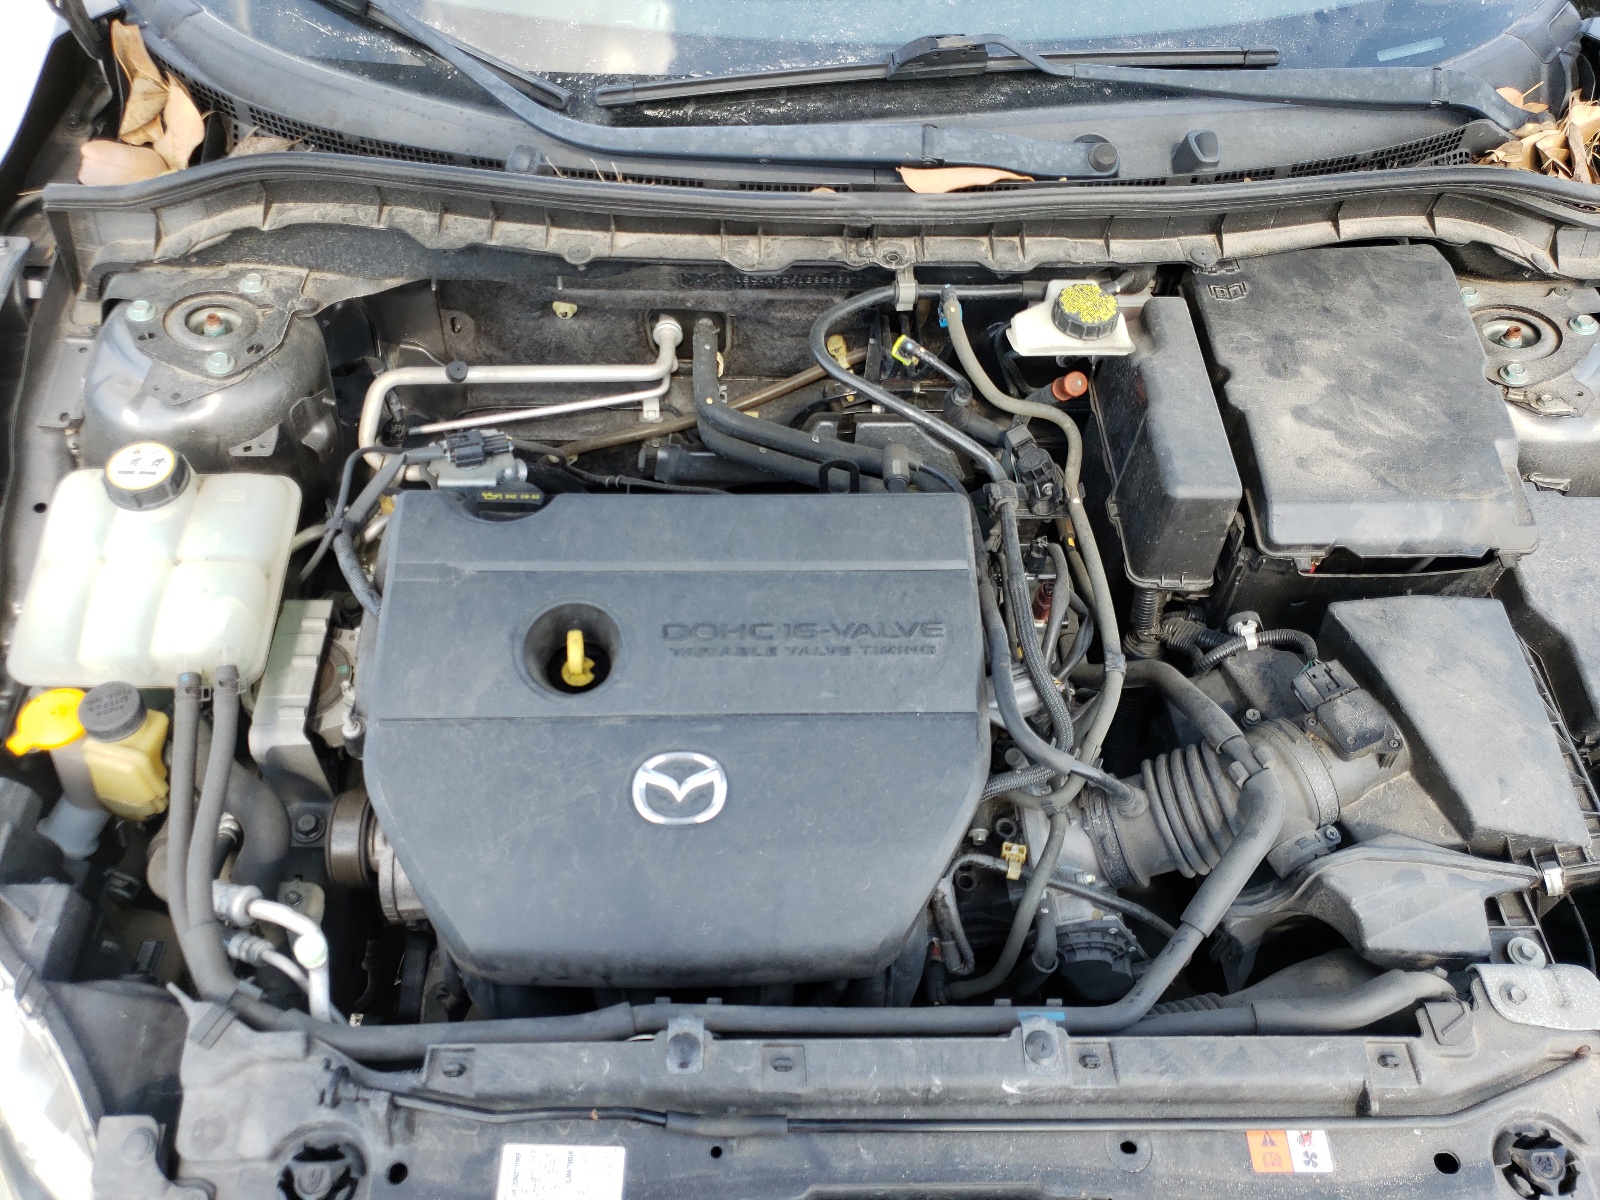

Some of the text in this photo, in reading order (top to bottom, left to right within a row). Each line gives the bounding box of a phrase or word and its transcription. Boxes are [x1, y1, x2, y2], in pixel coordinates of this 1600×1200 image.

[661, 620, 945, 641] DOHC 16-VALVE
[788, 646, 852, 657] VALVE
[859, 645, 937, 657] TIMING
